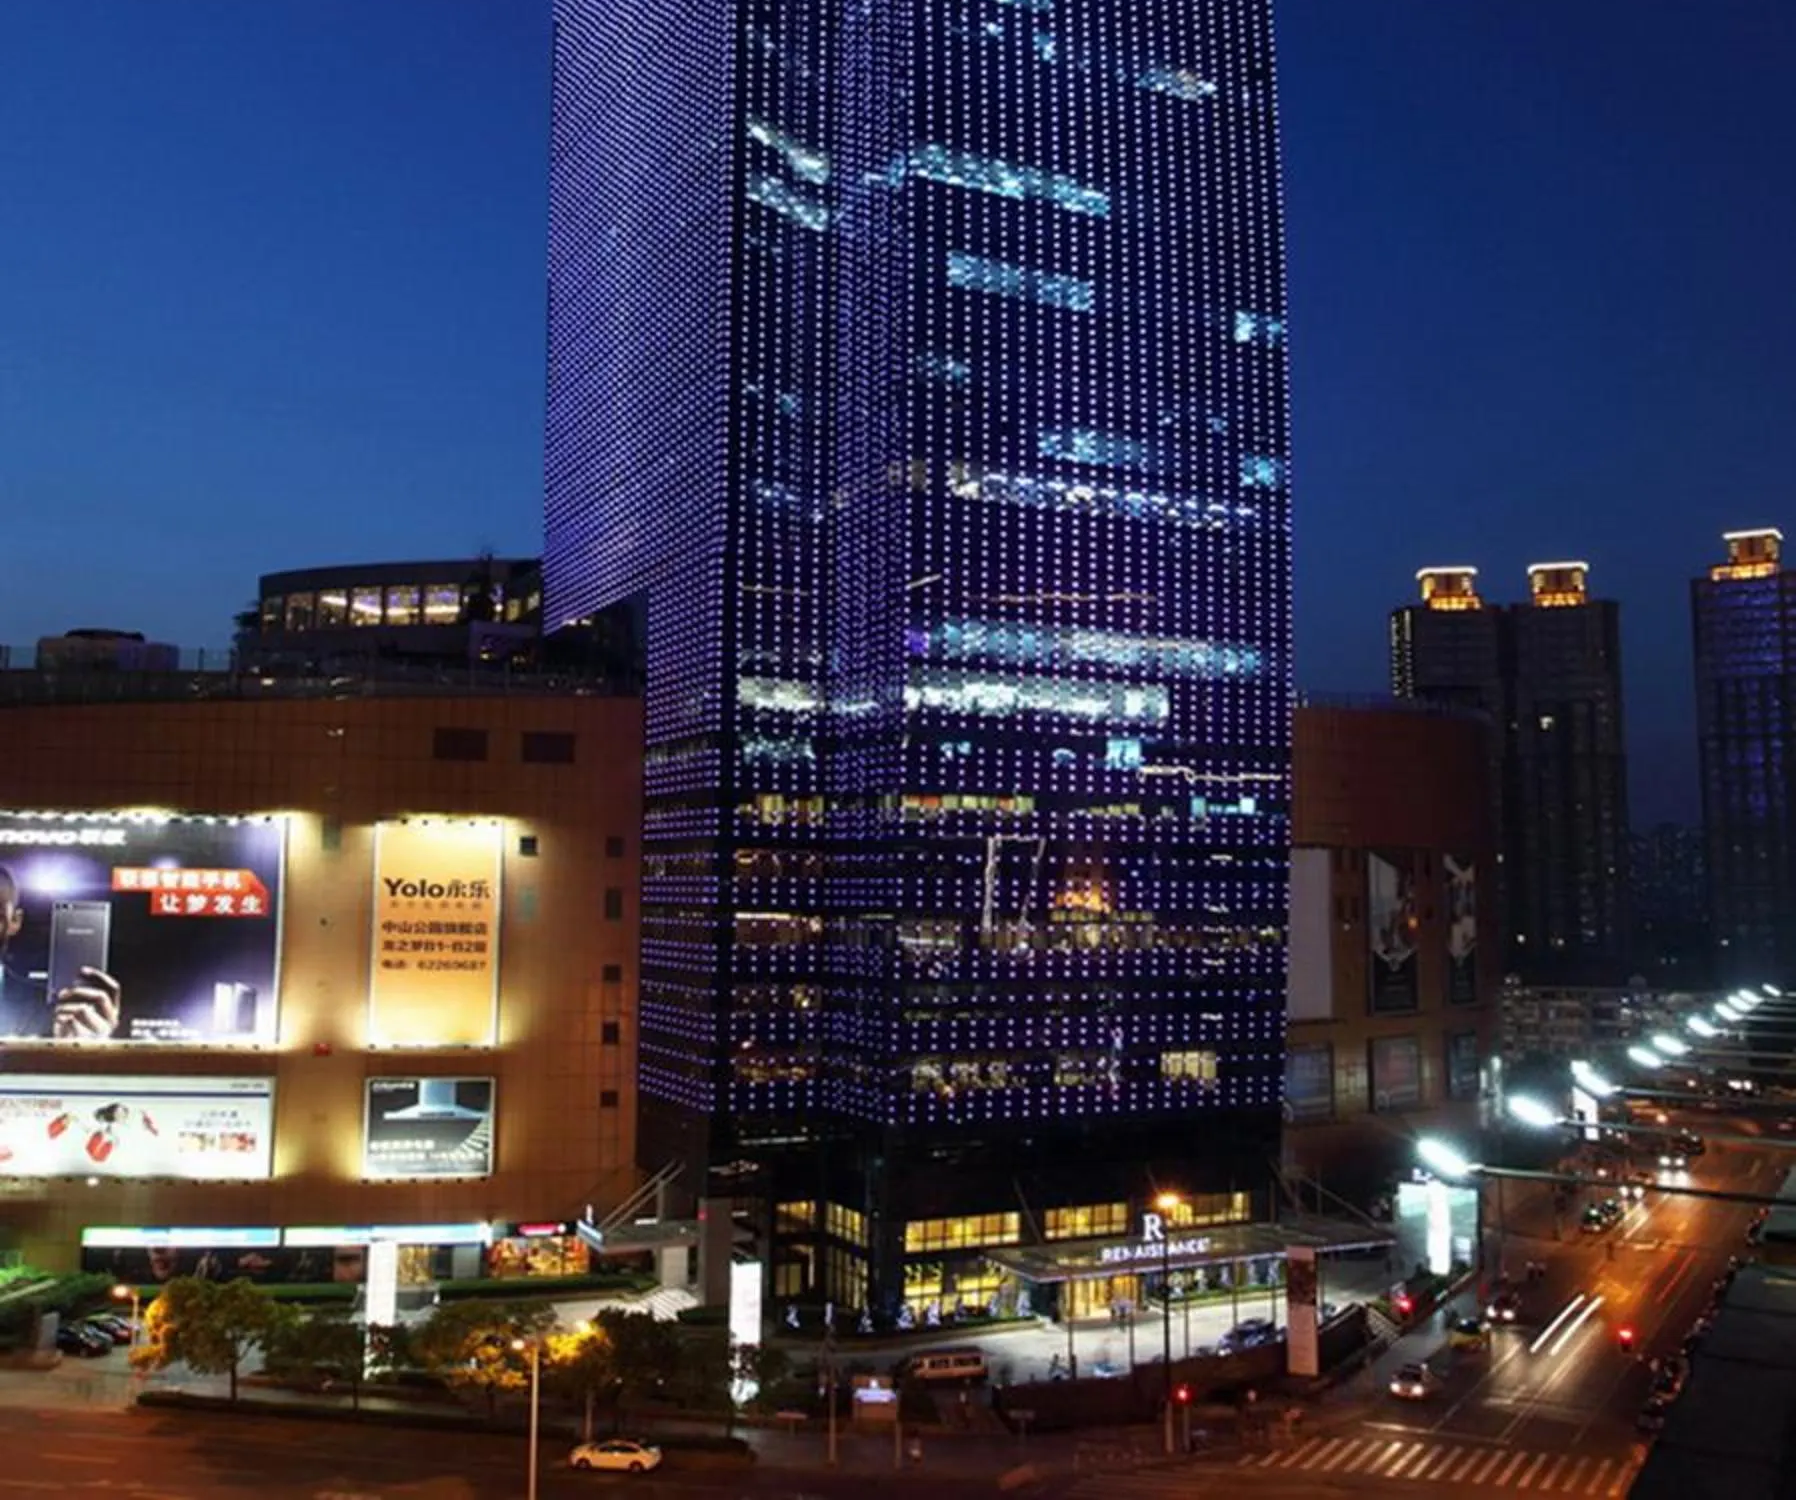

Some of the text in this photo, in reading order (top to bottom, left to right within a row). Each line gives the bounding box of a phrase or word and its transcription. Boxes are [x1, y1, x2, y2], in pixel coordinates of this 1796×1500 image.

[160, 893, 262, 912] 让梦发生
[1143, 1213, 1165, 1241] R
